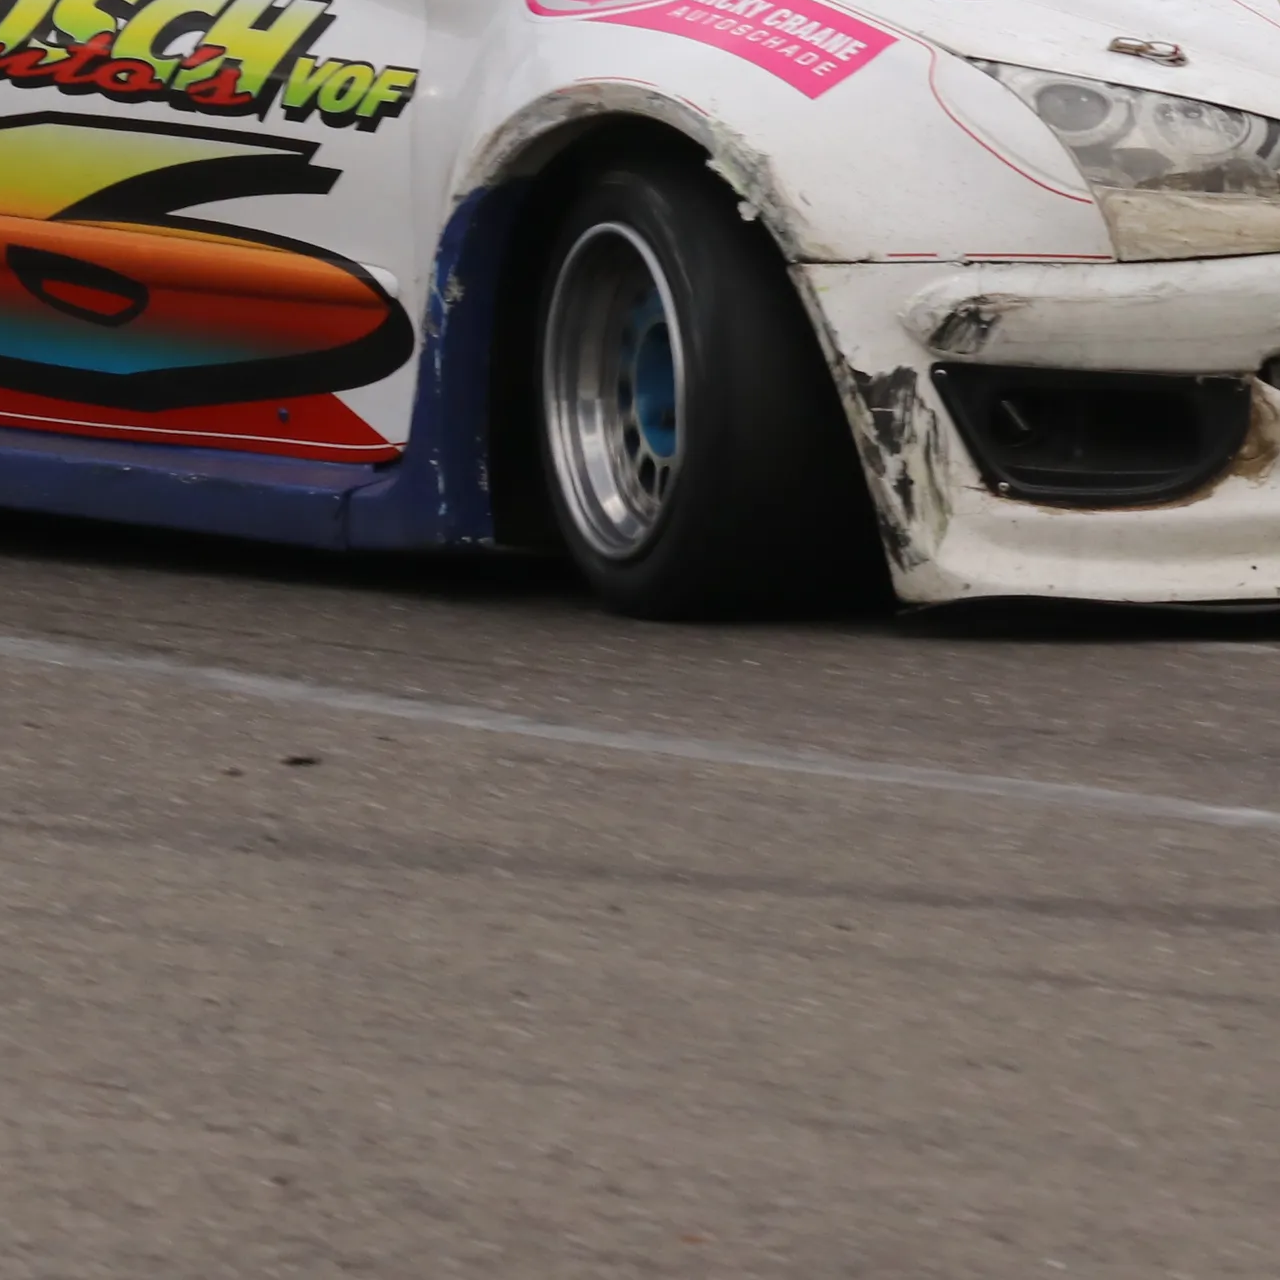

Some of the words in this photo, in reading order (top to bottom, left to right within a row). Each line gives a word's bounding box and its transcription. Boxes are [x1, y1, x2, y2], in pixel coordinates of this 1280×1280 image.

[667, 5, 837, 76] AUTOSCHADE
[766, 8, 867, 62] CRAANE
[279, 54, 418, 133] VOF
